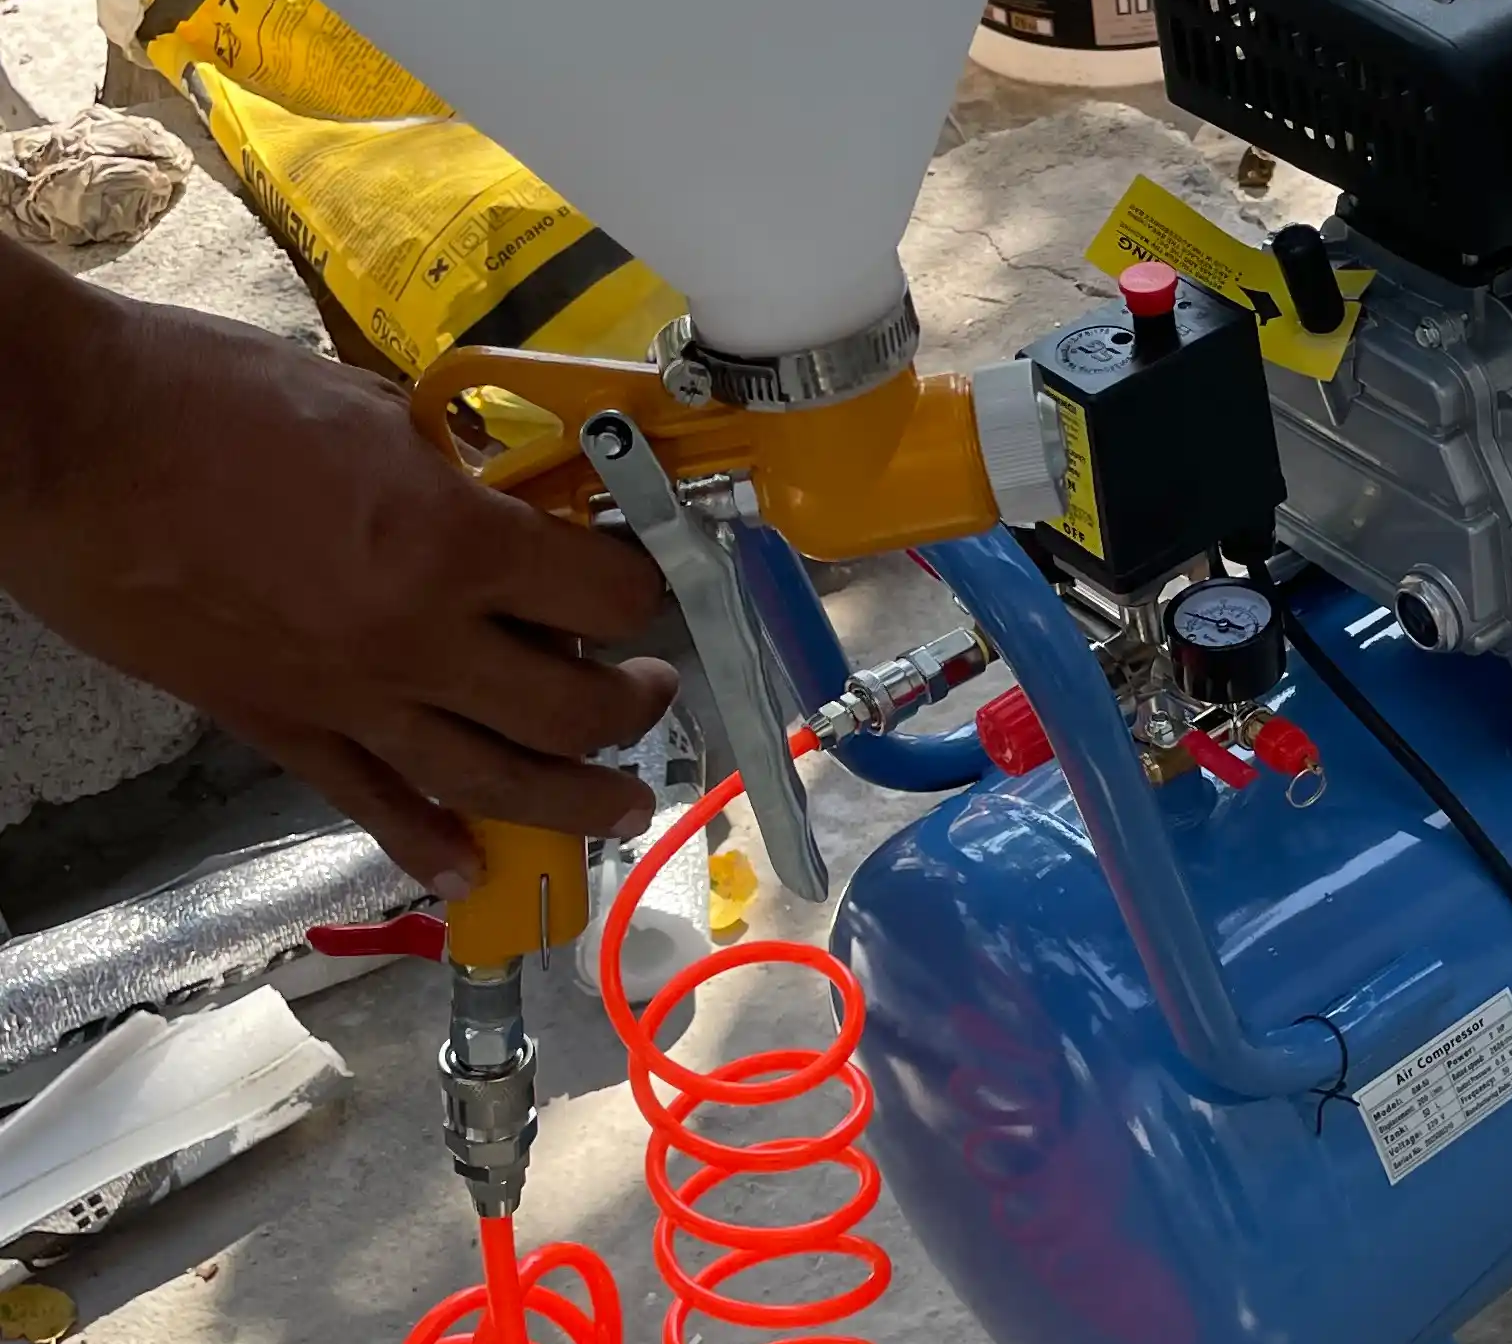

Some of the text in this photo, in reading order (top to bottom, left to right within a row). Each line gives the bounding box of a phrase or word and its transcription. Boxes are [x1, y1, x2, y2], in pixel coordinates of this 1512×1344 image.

[485, 216, 555, 271] Сделано
[1063, 521, 1086, 544] OFF
[1396, 1018, 1484, 1086] Air Compressor
[1446, 1046, 1476, 1069] Power:
[1460, 1077, 1496, 1104] Frequency:
[1373, 1098, 1403, 1122] Model:
[1383, 1125, 1408, 1145] Tank:
[1388, 1131, 1422, 1157] Voltage:
[1440, 1112, 1446, 1120] V
